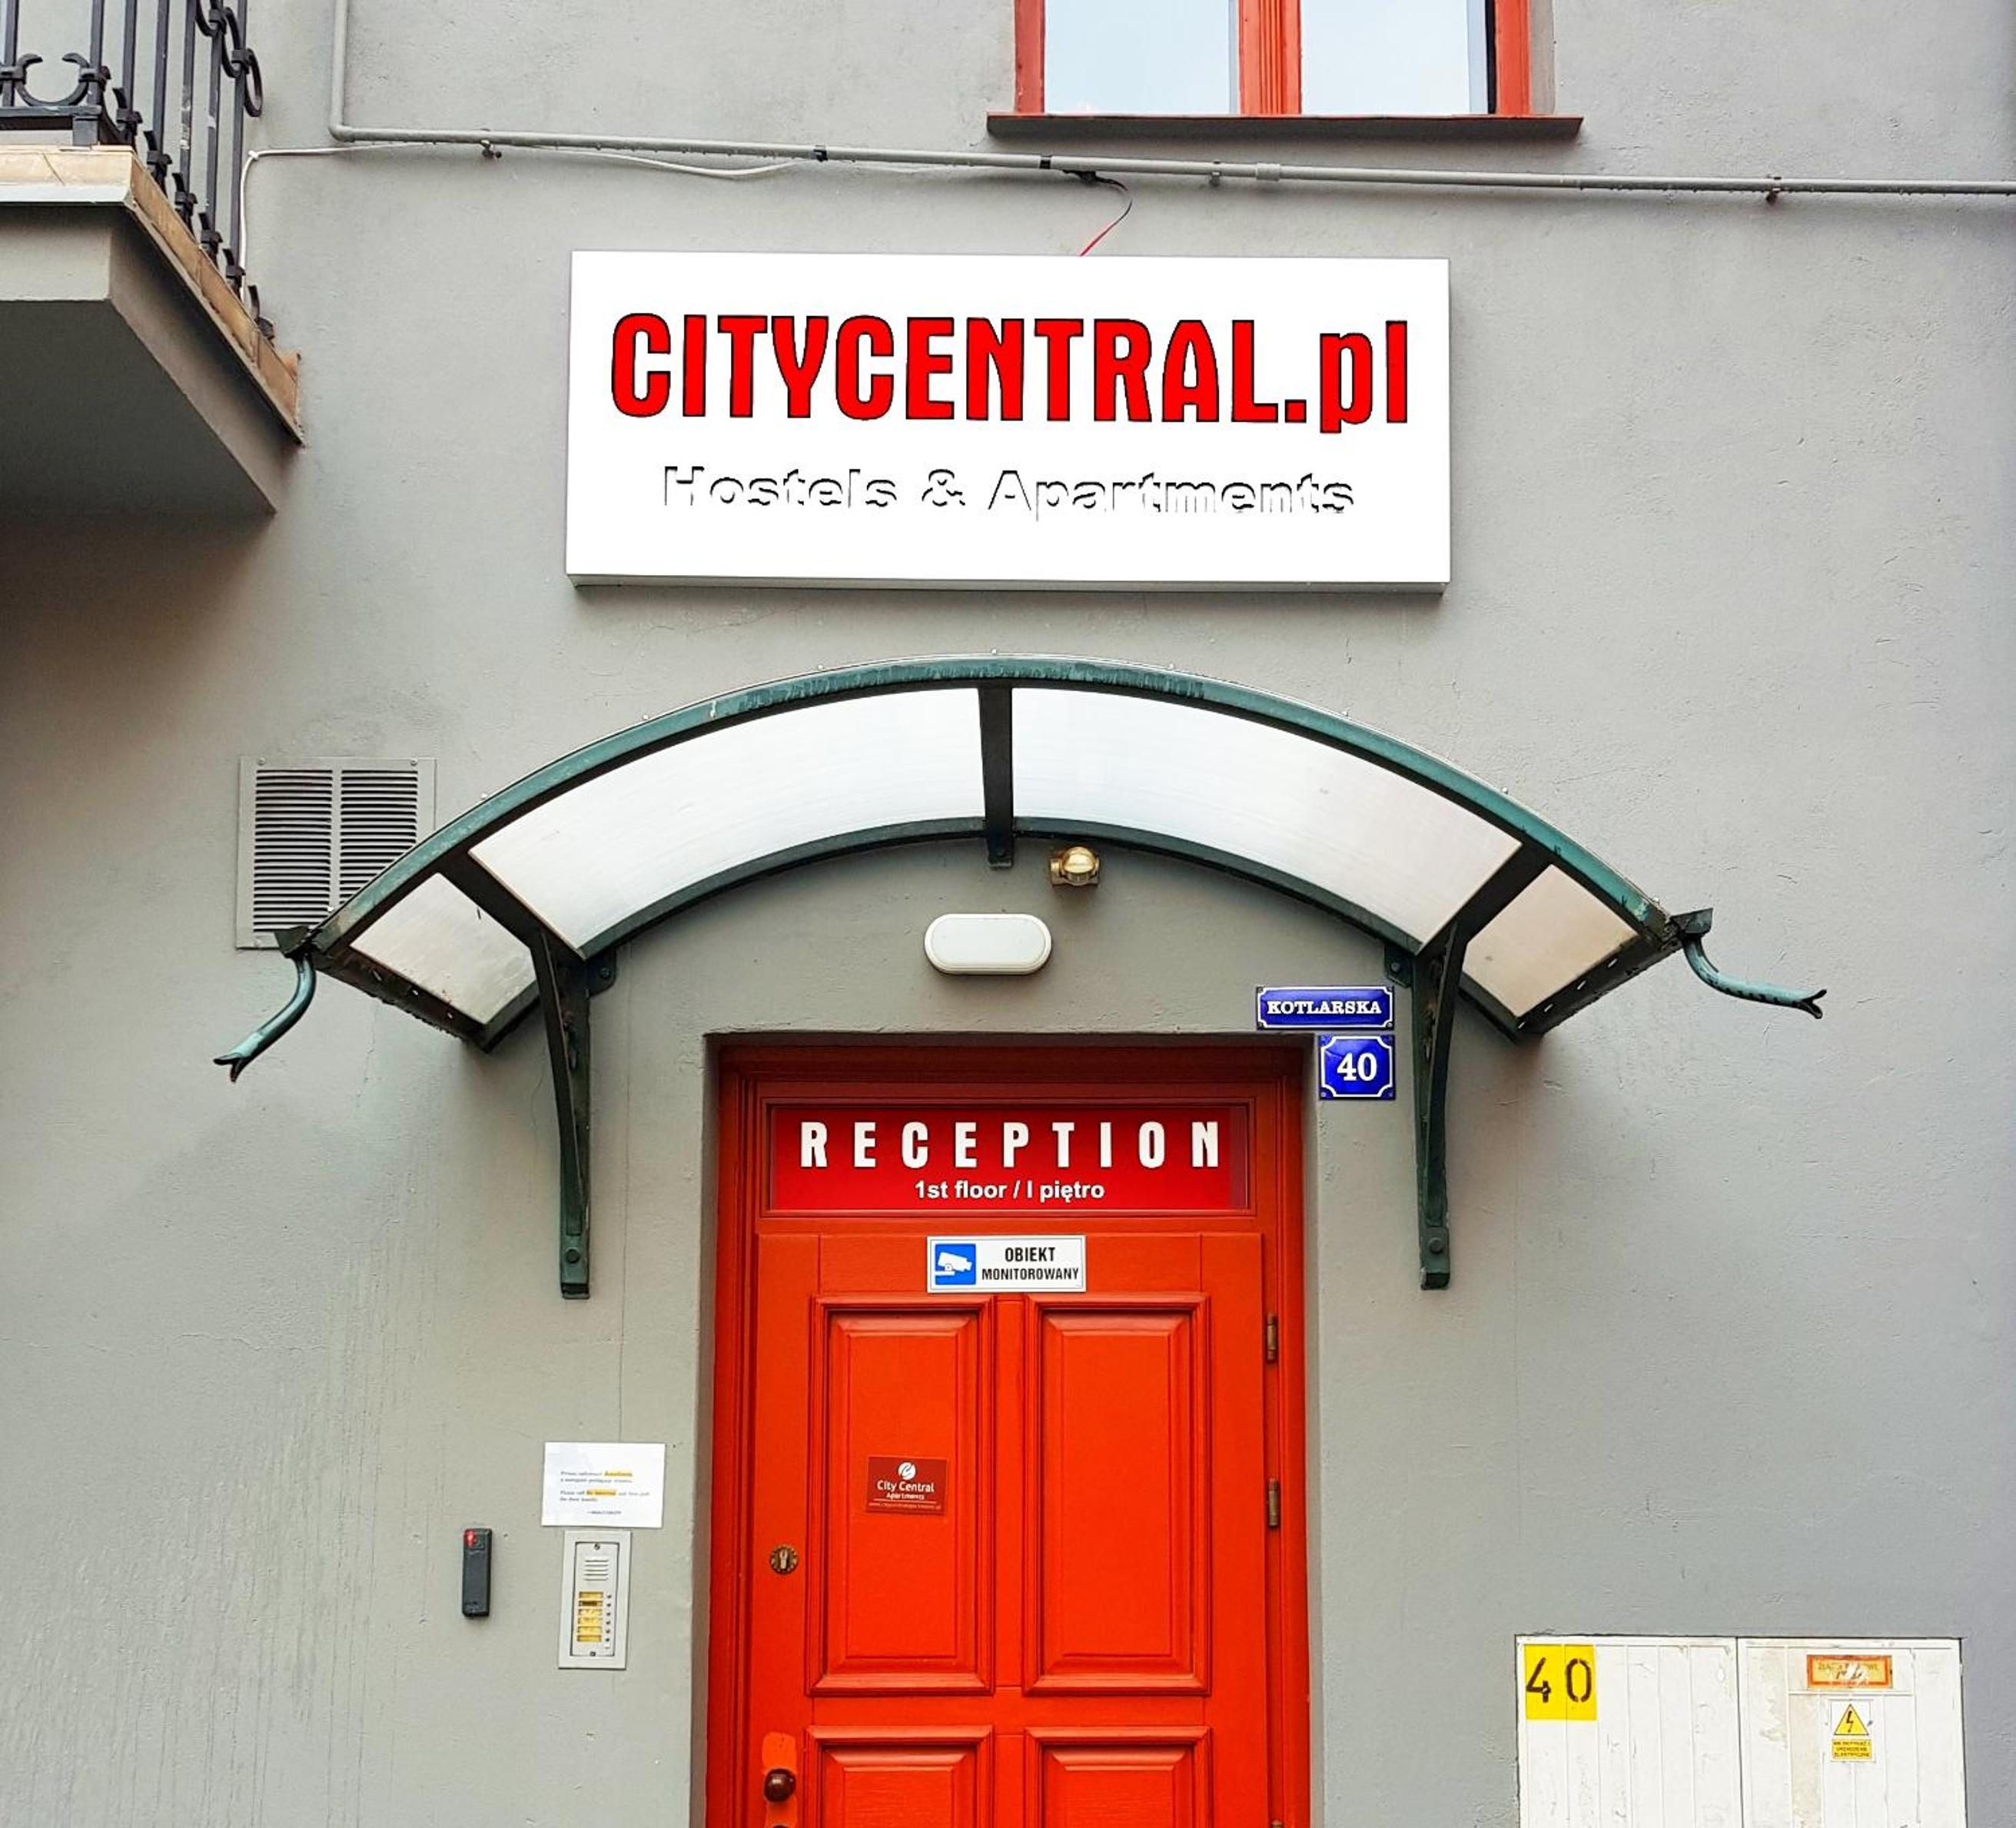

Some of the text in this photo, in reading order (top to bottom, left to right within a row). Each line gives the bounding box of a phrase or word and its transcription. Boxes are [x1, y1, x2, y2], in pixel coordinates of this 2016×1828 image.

[611, 312, 1409, 434] CITYCENTRAL.pl
[664, 466, 1354, 521] Hostels & Apartments
[1267, 1001, 1382, 1015] KOTLARSKA
[1337, 1052, 1378, 1082] 40
[800, 1121, 1219, 1168] RECEPTION
[915, 1180, 948, 1199] 1st
[955, 1180, 1008, 1199] floor
[1012, 1181, 1021, 1199] /
[1040, 1180, 1105, 1203] piętro
[1005, 1247, 1056, 1262] OBIEKT
[981, 1267, 1079, 1281] MONITOROWANY
[877, 1481, 935, 1492] City Central
[1526, 1656, 1593, 1703] 40
